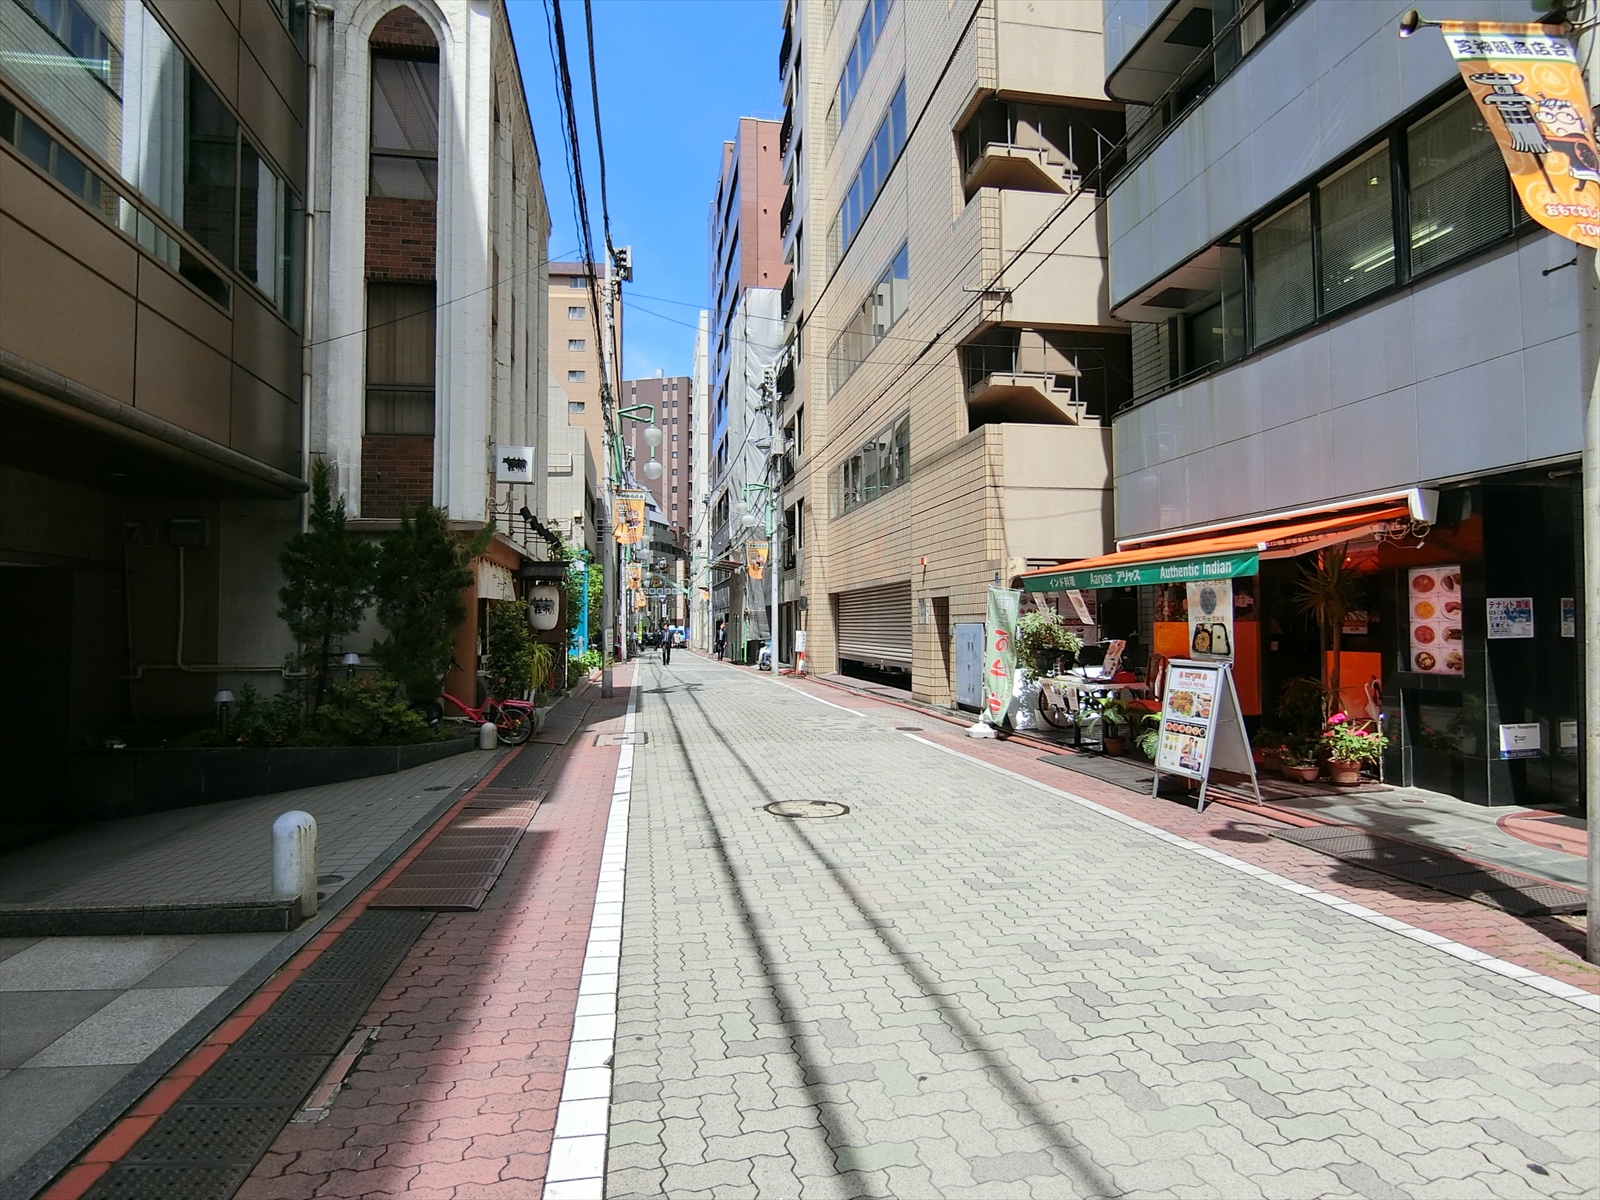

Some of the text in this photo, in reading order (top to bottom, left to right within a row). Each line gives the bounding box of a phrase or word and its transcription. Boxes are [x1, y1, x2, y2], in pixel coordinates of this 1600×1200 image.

[1049, 575, 1076, 588] インド料理
[1089, 572, 1113, 585] Aaryas
[1159, 563, 1200, 580] Authentic
[1202, 560, 1232, 575] Indian
